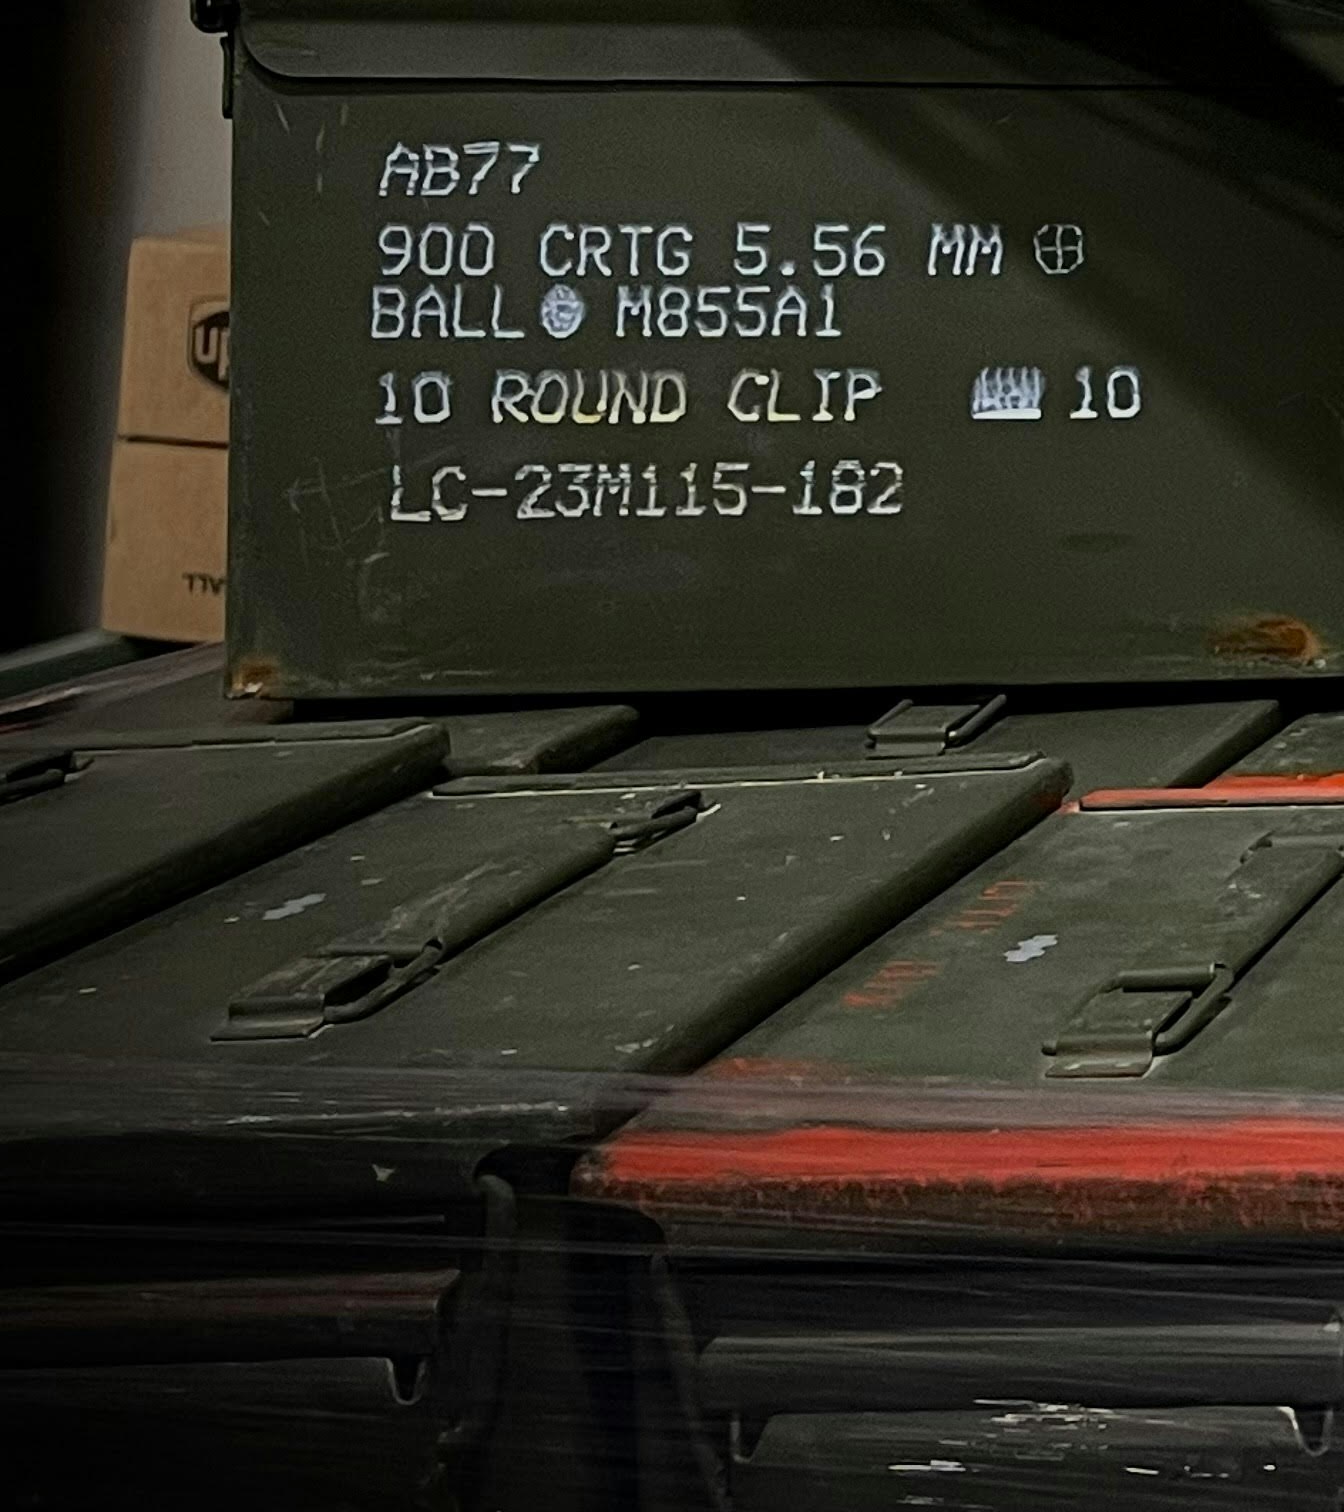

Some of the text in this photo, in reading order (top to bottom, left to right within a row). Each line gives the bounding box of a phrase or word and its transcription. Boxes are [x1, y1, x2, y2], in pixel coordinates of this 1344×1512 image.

[378, 141, 540, 197] AB77
[378, 222, 1003, 277] 900 CRTG 5.56 MM
[370, 283, 842, 339] BALL M855A1
[375, 366, 1141, 425] 10 ROUND CLIP 10
[390, 459, 904, 522] LC-23M115-182
